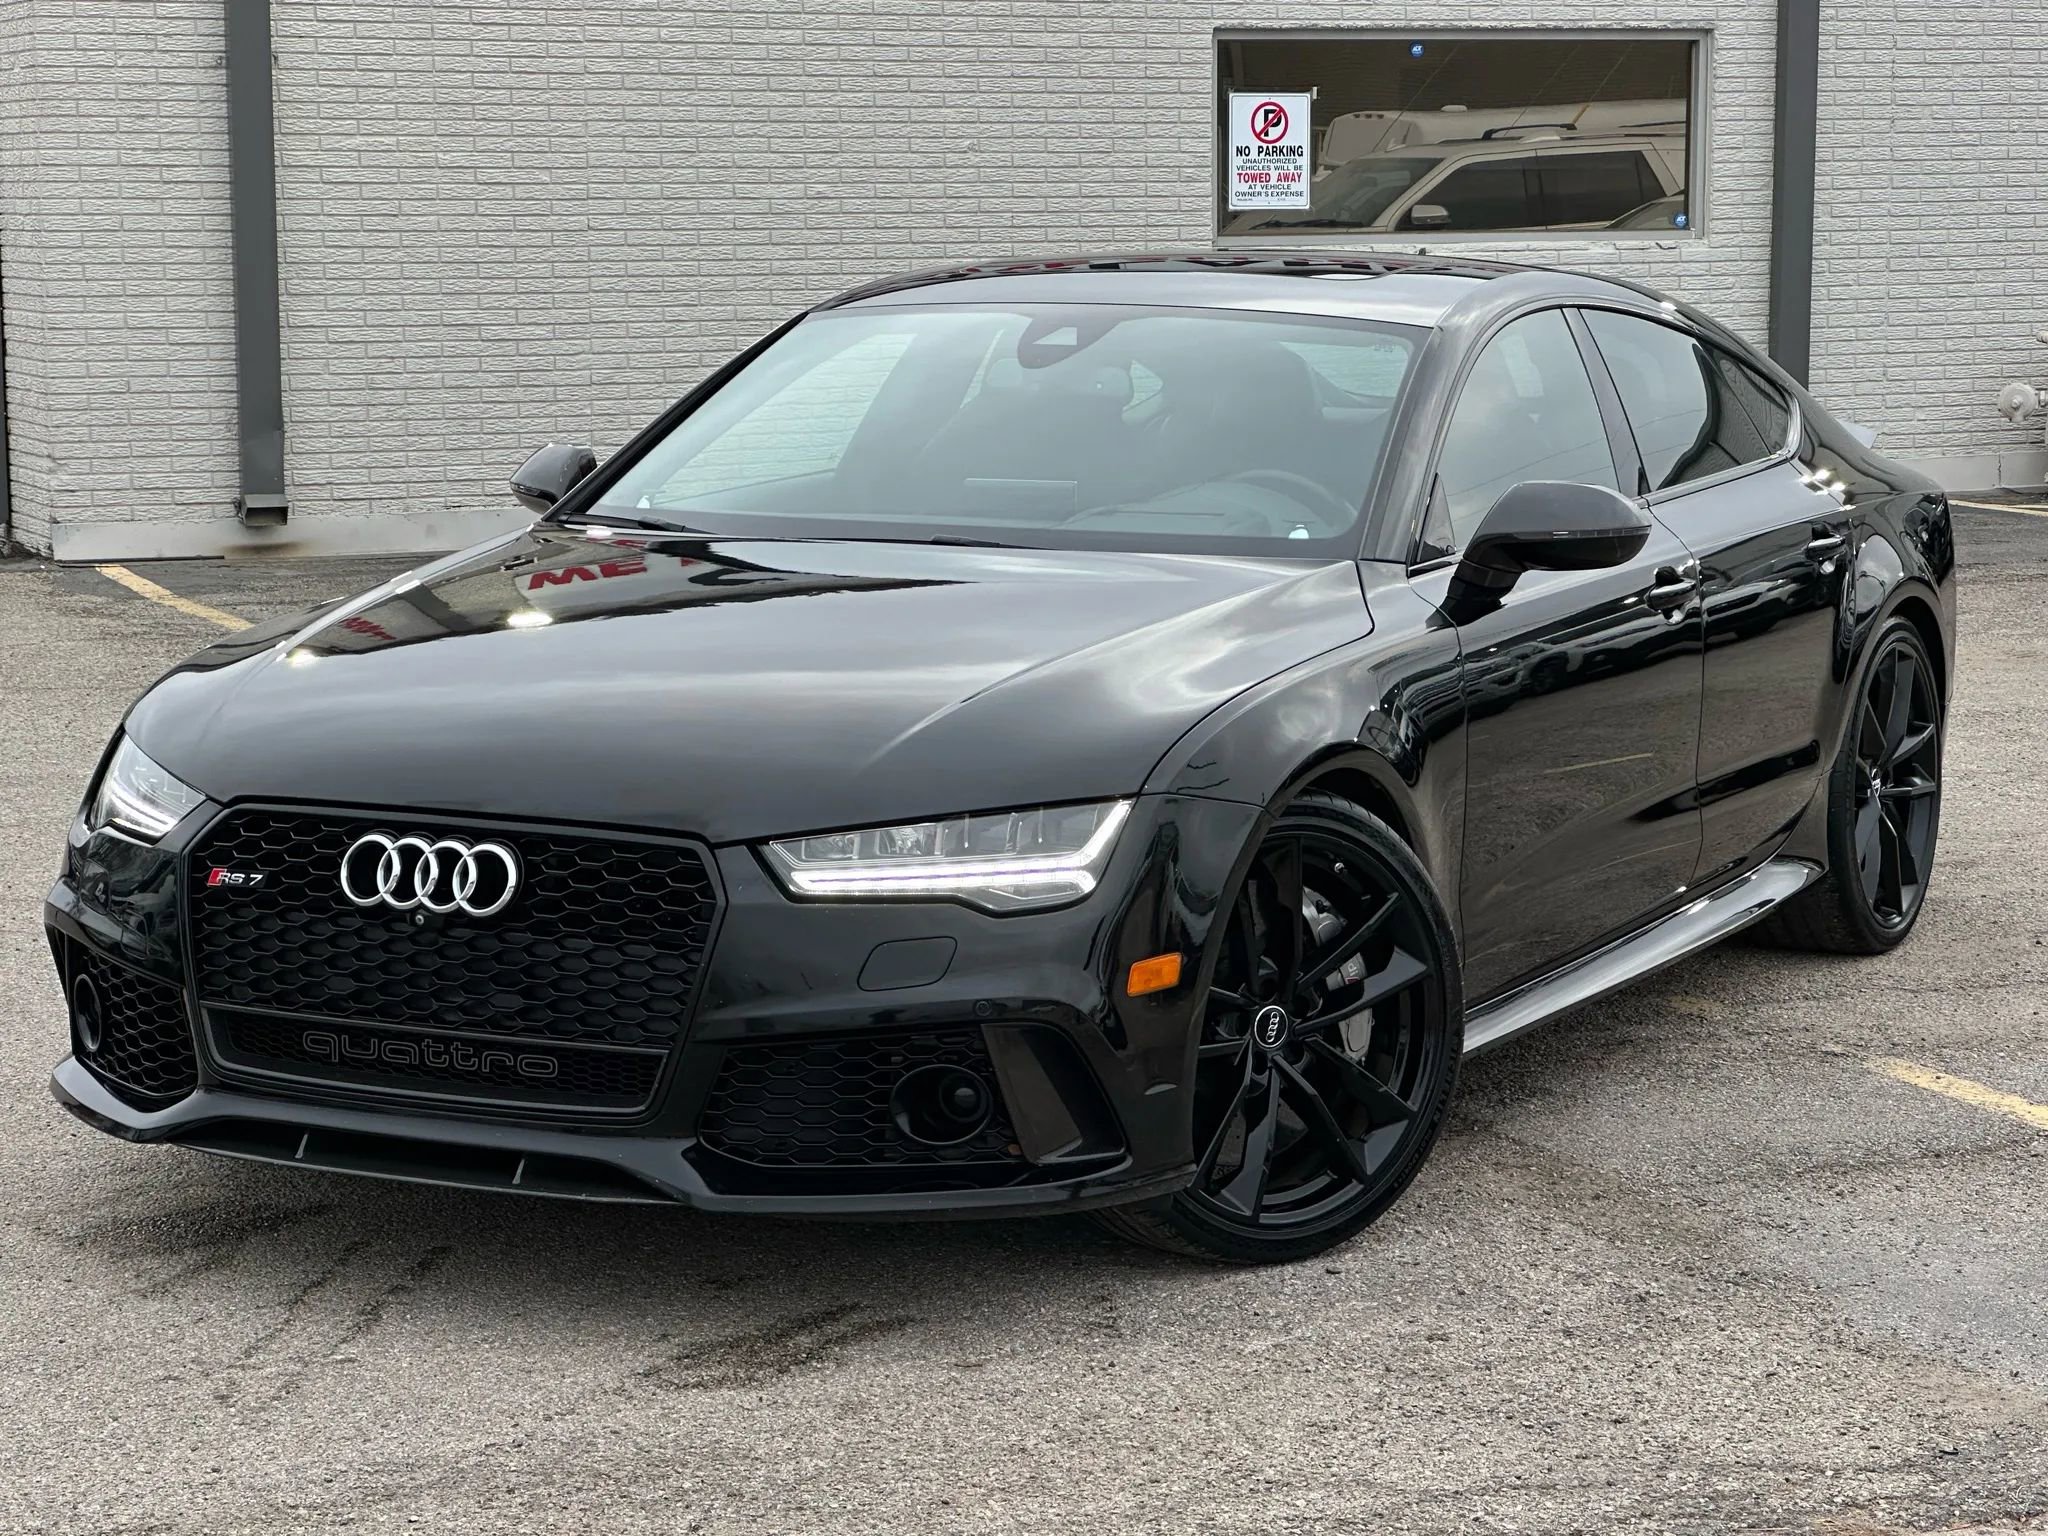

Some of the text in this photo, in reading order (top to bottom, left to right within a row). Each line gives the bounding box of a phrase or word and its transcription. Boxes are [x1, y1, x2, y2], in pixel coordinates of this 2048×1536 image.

[1235, 145, 1304, 157] NO PARKING
[1236, 172, 1303, 183] TOWED AWAY
[214, 871, 264, 886] RS 7
[302, 1030, 559, 1078] quattro
